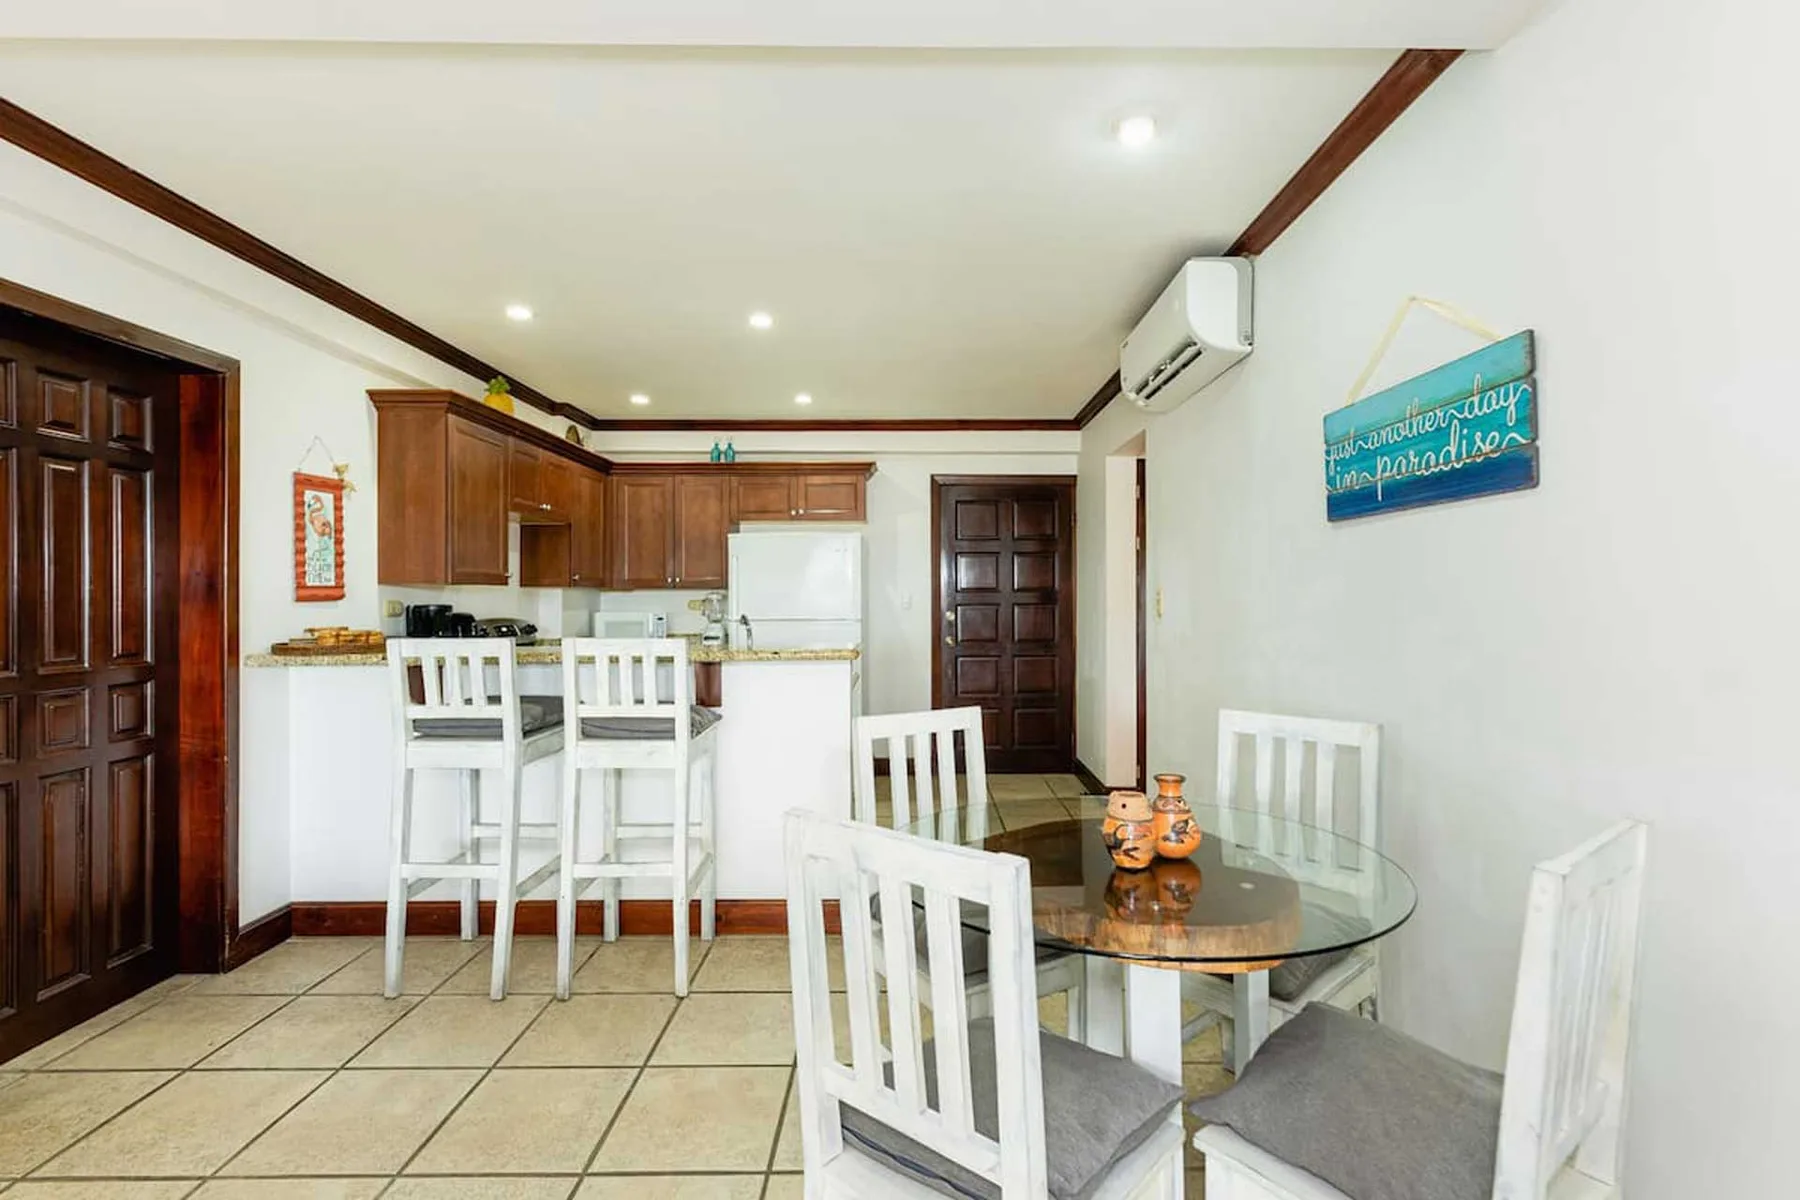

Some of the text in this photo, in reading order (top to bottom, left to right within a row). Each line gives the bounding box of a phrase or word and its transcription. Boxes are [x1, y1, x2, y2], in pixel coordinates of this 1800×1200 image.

[1324, 373, 1532, 476] just another day
[1326, 420, 1531, 502] in paradise
